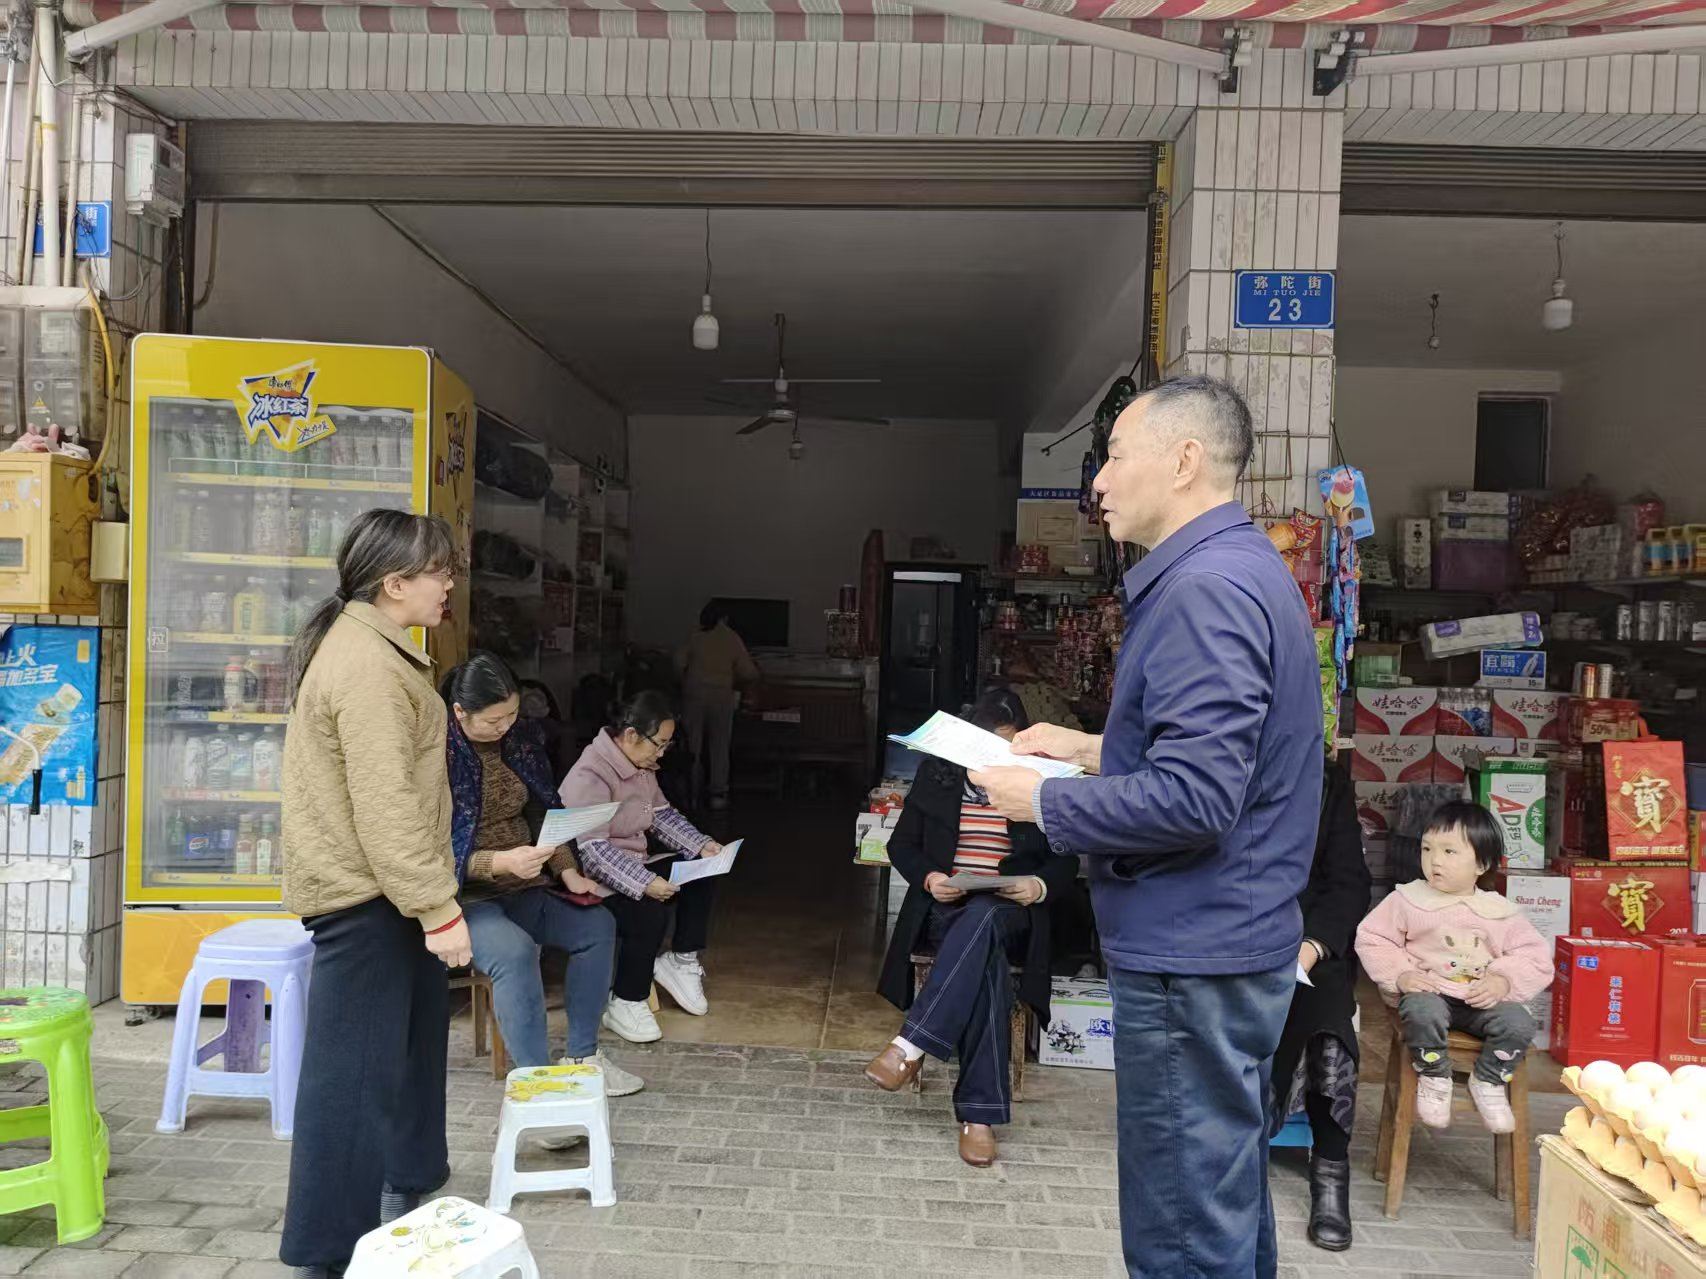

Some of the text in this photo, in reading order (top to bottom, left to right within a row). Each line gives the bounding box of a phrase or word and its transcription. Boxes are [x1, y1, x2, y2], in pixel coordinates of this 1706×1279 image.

[1254, 275, 1322, 289] 弥陀街
[1268, 298, 1302, 321] 23
[247, 392, 309, 428] 冰红茶
[1371, 694, 1422, 709] 娃哈哈
[1368, 741, 1417, 757] 娃哈哈
[1515, 896, 1561, 907] Shan Cheng
